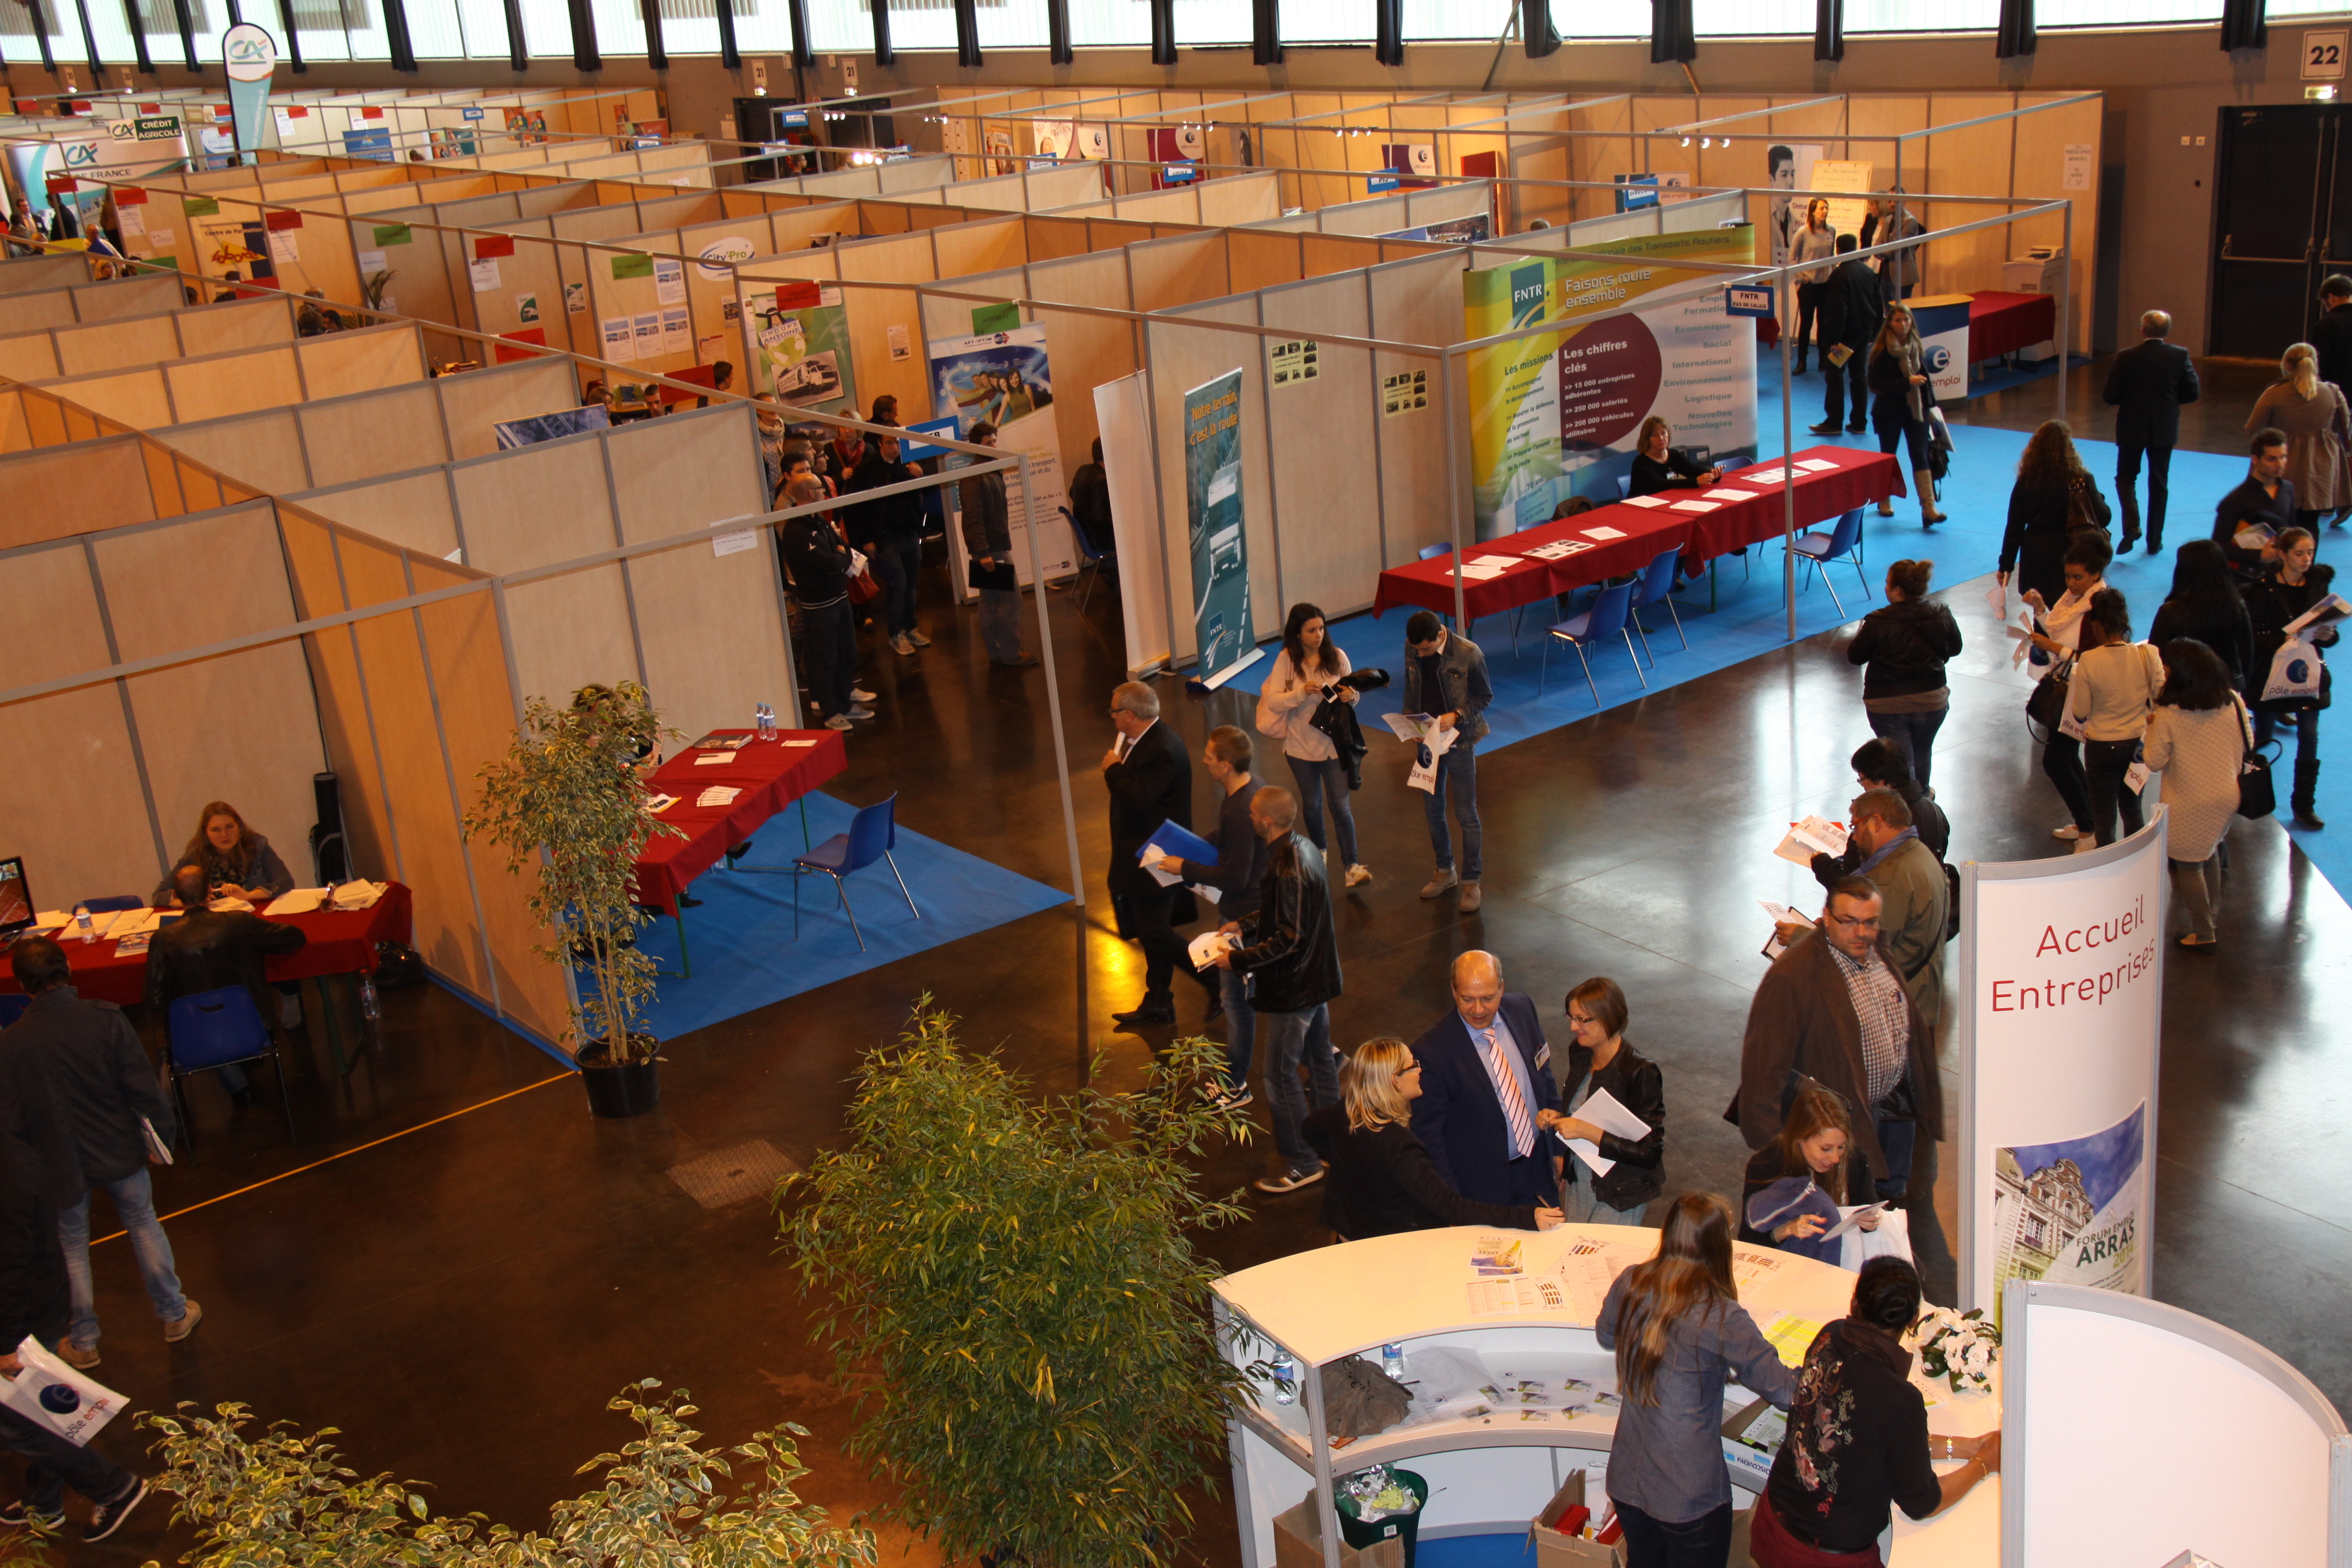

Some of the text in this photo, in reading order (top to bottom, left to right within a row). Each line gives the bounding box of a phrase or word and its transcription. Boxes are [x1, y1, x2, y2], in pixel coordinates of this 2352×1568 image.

[2310, 46, 2339, 64] 22
[756, 67, 764, 77] 21
[847, 66, 854, 77] 21
[142, 119, 173, 129] CRÉDIT
[138, 129, 180, 140] AGRICOLE
[91, 169, 132, 179] FRANCE
[1628, 245, 1642, 253] des
[1646, 240, 1689, 251] Transports
[1693, 236, 1730, 245] Routiers
[1565, 268, 1651, 293] Faisons route
[1515, 284, 1542, 303] FNTR
[1566, 287, 1626, 308] ensemble
[1699, 294, 1726, 304] Emplo
[1684, 306, 1726, 315] Formatio
[761, 323, 798, 338] GROUPE
[1674, 323, 1731, 333] Économique
[764, 327, 800, 343] ANTOINE
[1564, 341, 1627, 359] Les chiffres
[1703, 340, 1731, 348] Social
[1505, 352, 1554, 376] Les missions
[1565, 362, 1587, 374] clés
[1672, 357, 1732, 369] International
[1512, 375, 1542, 391] Accompagner
[1598, 373, 1635, 385] entreprises
[1664, 375, 1732, 387] Environnement
[1931, 374, 1960, 388] emploi
[1511, 385, 1544, 403] développement
[1565, 388, 1601, 400] adhérentes
[1685, 393, 1732, 403] Logistique
[1192, 389, 1237, 422] Notre terrain,
[1601, 397, 1628, 407] salariés
[1513, 409, 1529, 419] Assurer
[1535, 399, 1555, 410] défense
[1688, 410, 1733, 420] Nouvelles
[1601, 411, 1634, 421] véhicules
[1189, 413, 1238, 445] c'est la route
[1517, 416, 1539, 430] promotion
[1672, 421, 1733, 431] Technologies
[1513, 430, 1530, 442] secteur
[1566, 427, 1596, 439] utilitaires
[1514, 440, 1551, 459] Préparer l'avenir
[1519, 458, 1531, 467] route
[1526, 477, 1545, 491] 70 ans
[1210, 623, 1223, 637] FNTR
[2269, 686, 2289, 695] pôle
[2062, 720, 2074, 731] pôle
[1411, 769, 1421, 779] ôle
[2035, 893, 2144, 958] Accueil
[1992, 938, 2154, 1012] Entreprises
[2076, 1208, 2135, 1247] FORUM EMPLOI
[2075, 1218, 2134, 1268] ARRAS
[65, 1420, 86, 1440] pôle
[1736, 1457, 1771, 1476] DISCOVERY
